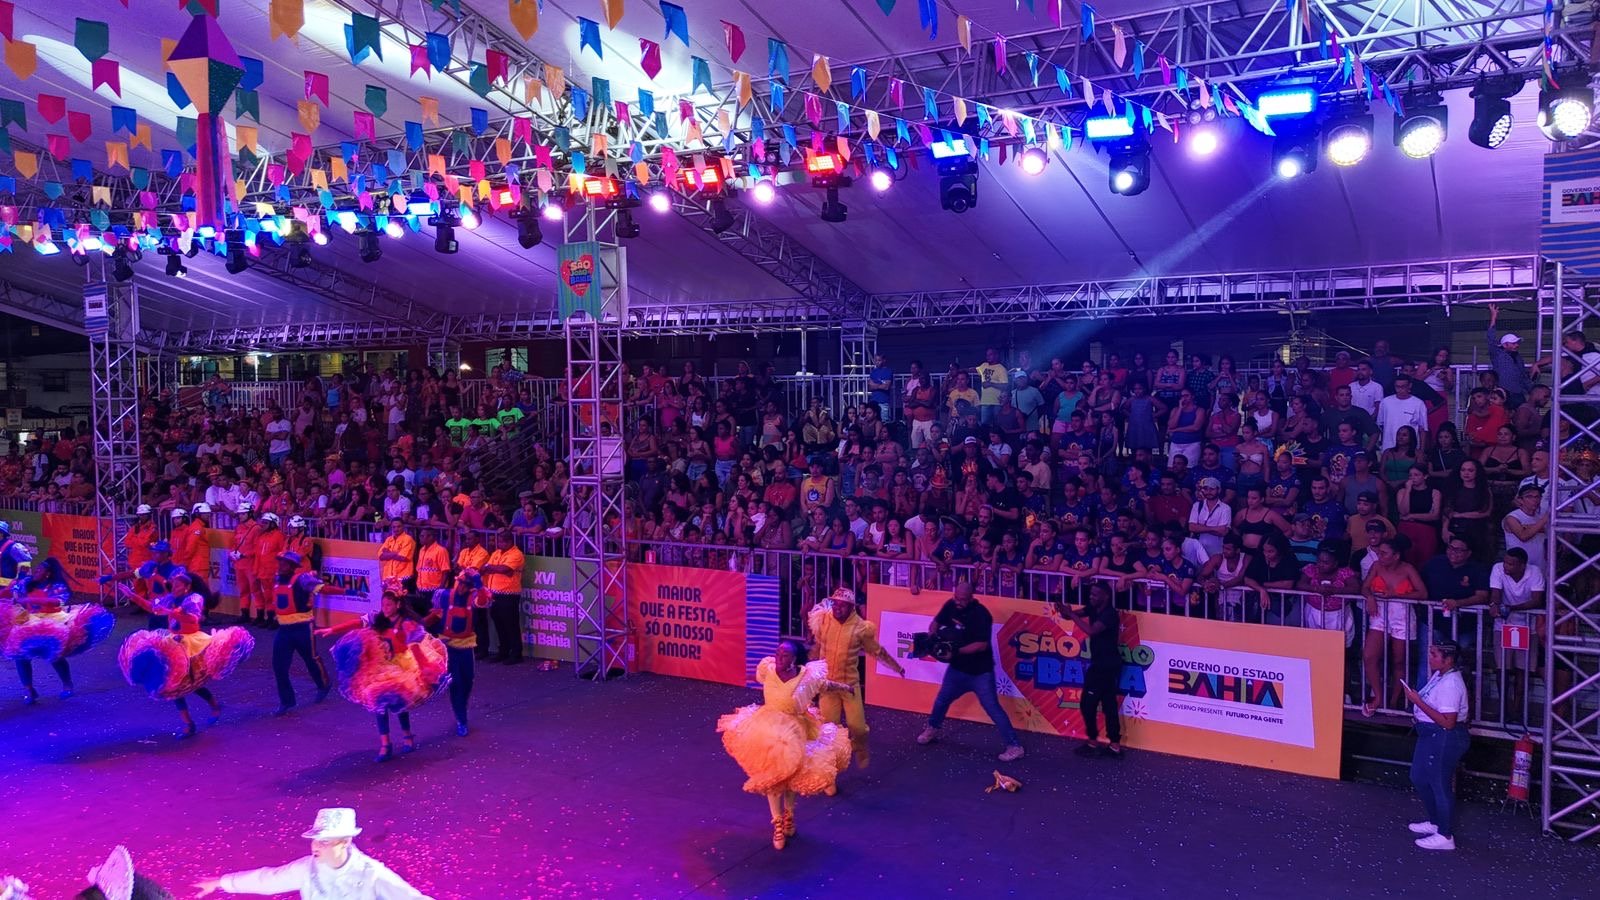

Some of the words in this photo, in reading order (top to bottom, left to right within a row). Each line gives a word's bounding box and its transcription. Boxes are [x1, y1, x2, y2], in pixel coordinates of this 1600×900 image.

[72, 529, 95, 540] MAIOR
[64, 541, 77, 552] QUE
[78, 543, 83, 552] A
[83, 543, 99, 553] FEST
[534, 571, 556, 585] XVI
[522, 588, 584, 604] mpeonato
[658, 585, 702, 602] MAIOR
[640, 601, 665, 617] QUE
[667, 604, 676, 619] A
[678, 605, 720, 626] FESTA,
[537, 632, 571, 648] Bahia
[645, 619, 660, 636] SÓ
[663, 622, 672, 637] O
[674, 623, 714, 642] NOSSO
[897, 632, 914, 640] Bahi
[658, 641, 702, 660] AMOR!
[1018, 631, 1081, 658] SÃO
[1035, 656, 1146, 696] BAA
[1168, 658, 1221, 673] GOVERNO
[1224, 665, 1239, 676] DO
[1242, 667, 1284, 681] ESTADO
[1168, 668, 1283, 708] BAHIA
[1167, 702, 1197, 712] GOVERNO
[1197, 707, 1223, 716] PRESENTE
[1225, 711, 1249, 720] FUTURO
[1263, 716, 1283, 724] GENTE
